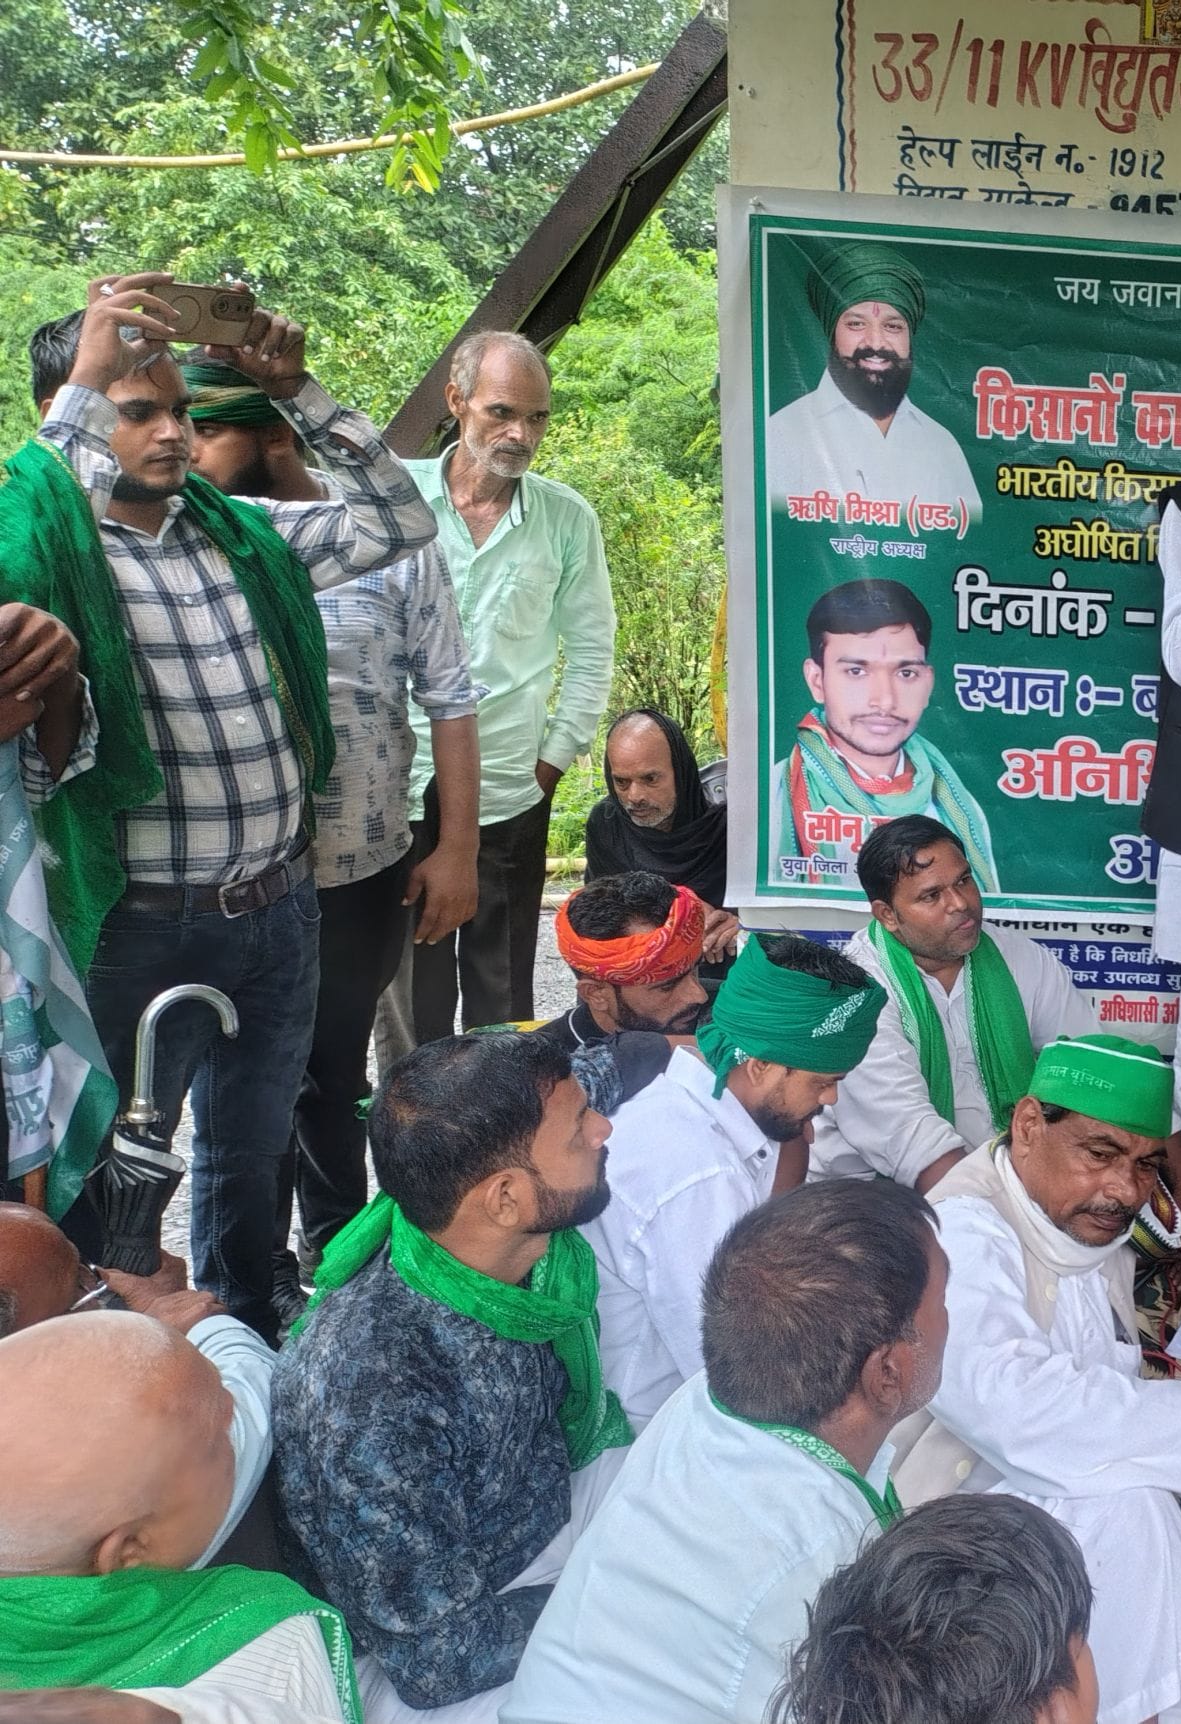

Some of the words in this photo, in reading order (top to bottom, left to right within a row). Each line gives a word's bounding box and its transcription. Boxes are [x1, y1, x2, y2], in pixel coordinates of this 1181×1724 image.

[872, 18, 1005, 116] 33/11
[1016, 40, 1076, 109] KV
[897, 126, 962, 171] हेल्प
[970, 132, 1048, 179] लाईन
[1109, 147, 1166, 180] 1912
[1054, 276, 1101, 305] जय
[973, 366, 1127, 445] किसानों
[997, 458, 1100, 501] भारतीय
[788, 490, 840, 523] ऋषि
[845, 492, 901, 527] मिश्रा
[907, 494, 969, 540] (एड.)
[830, 534, 878, 559] राष्ट्रीय
[881, 540, 927, 559] अध्यक्ष
[1034, 520, 1143, 562] अघोषित
[953, 566, 1114, 638] दिनांक
[954, 665, 1068, 717] स्थान
[803, 805, 866, 854] सोनू
[780, 856, 809, 877] युवा
[812, 853, 849, 875] जिला
[1068, 944, 1080, 963] है
[1085, 944, 1107, 962] कि
[1103, 971, 1161, 986] उपलब्ध
[1099, 994, 1160, 1023] अधिशासी
